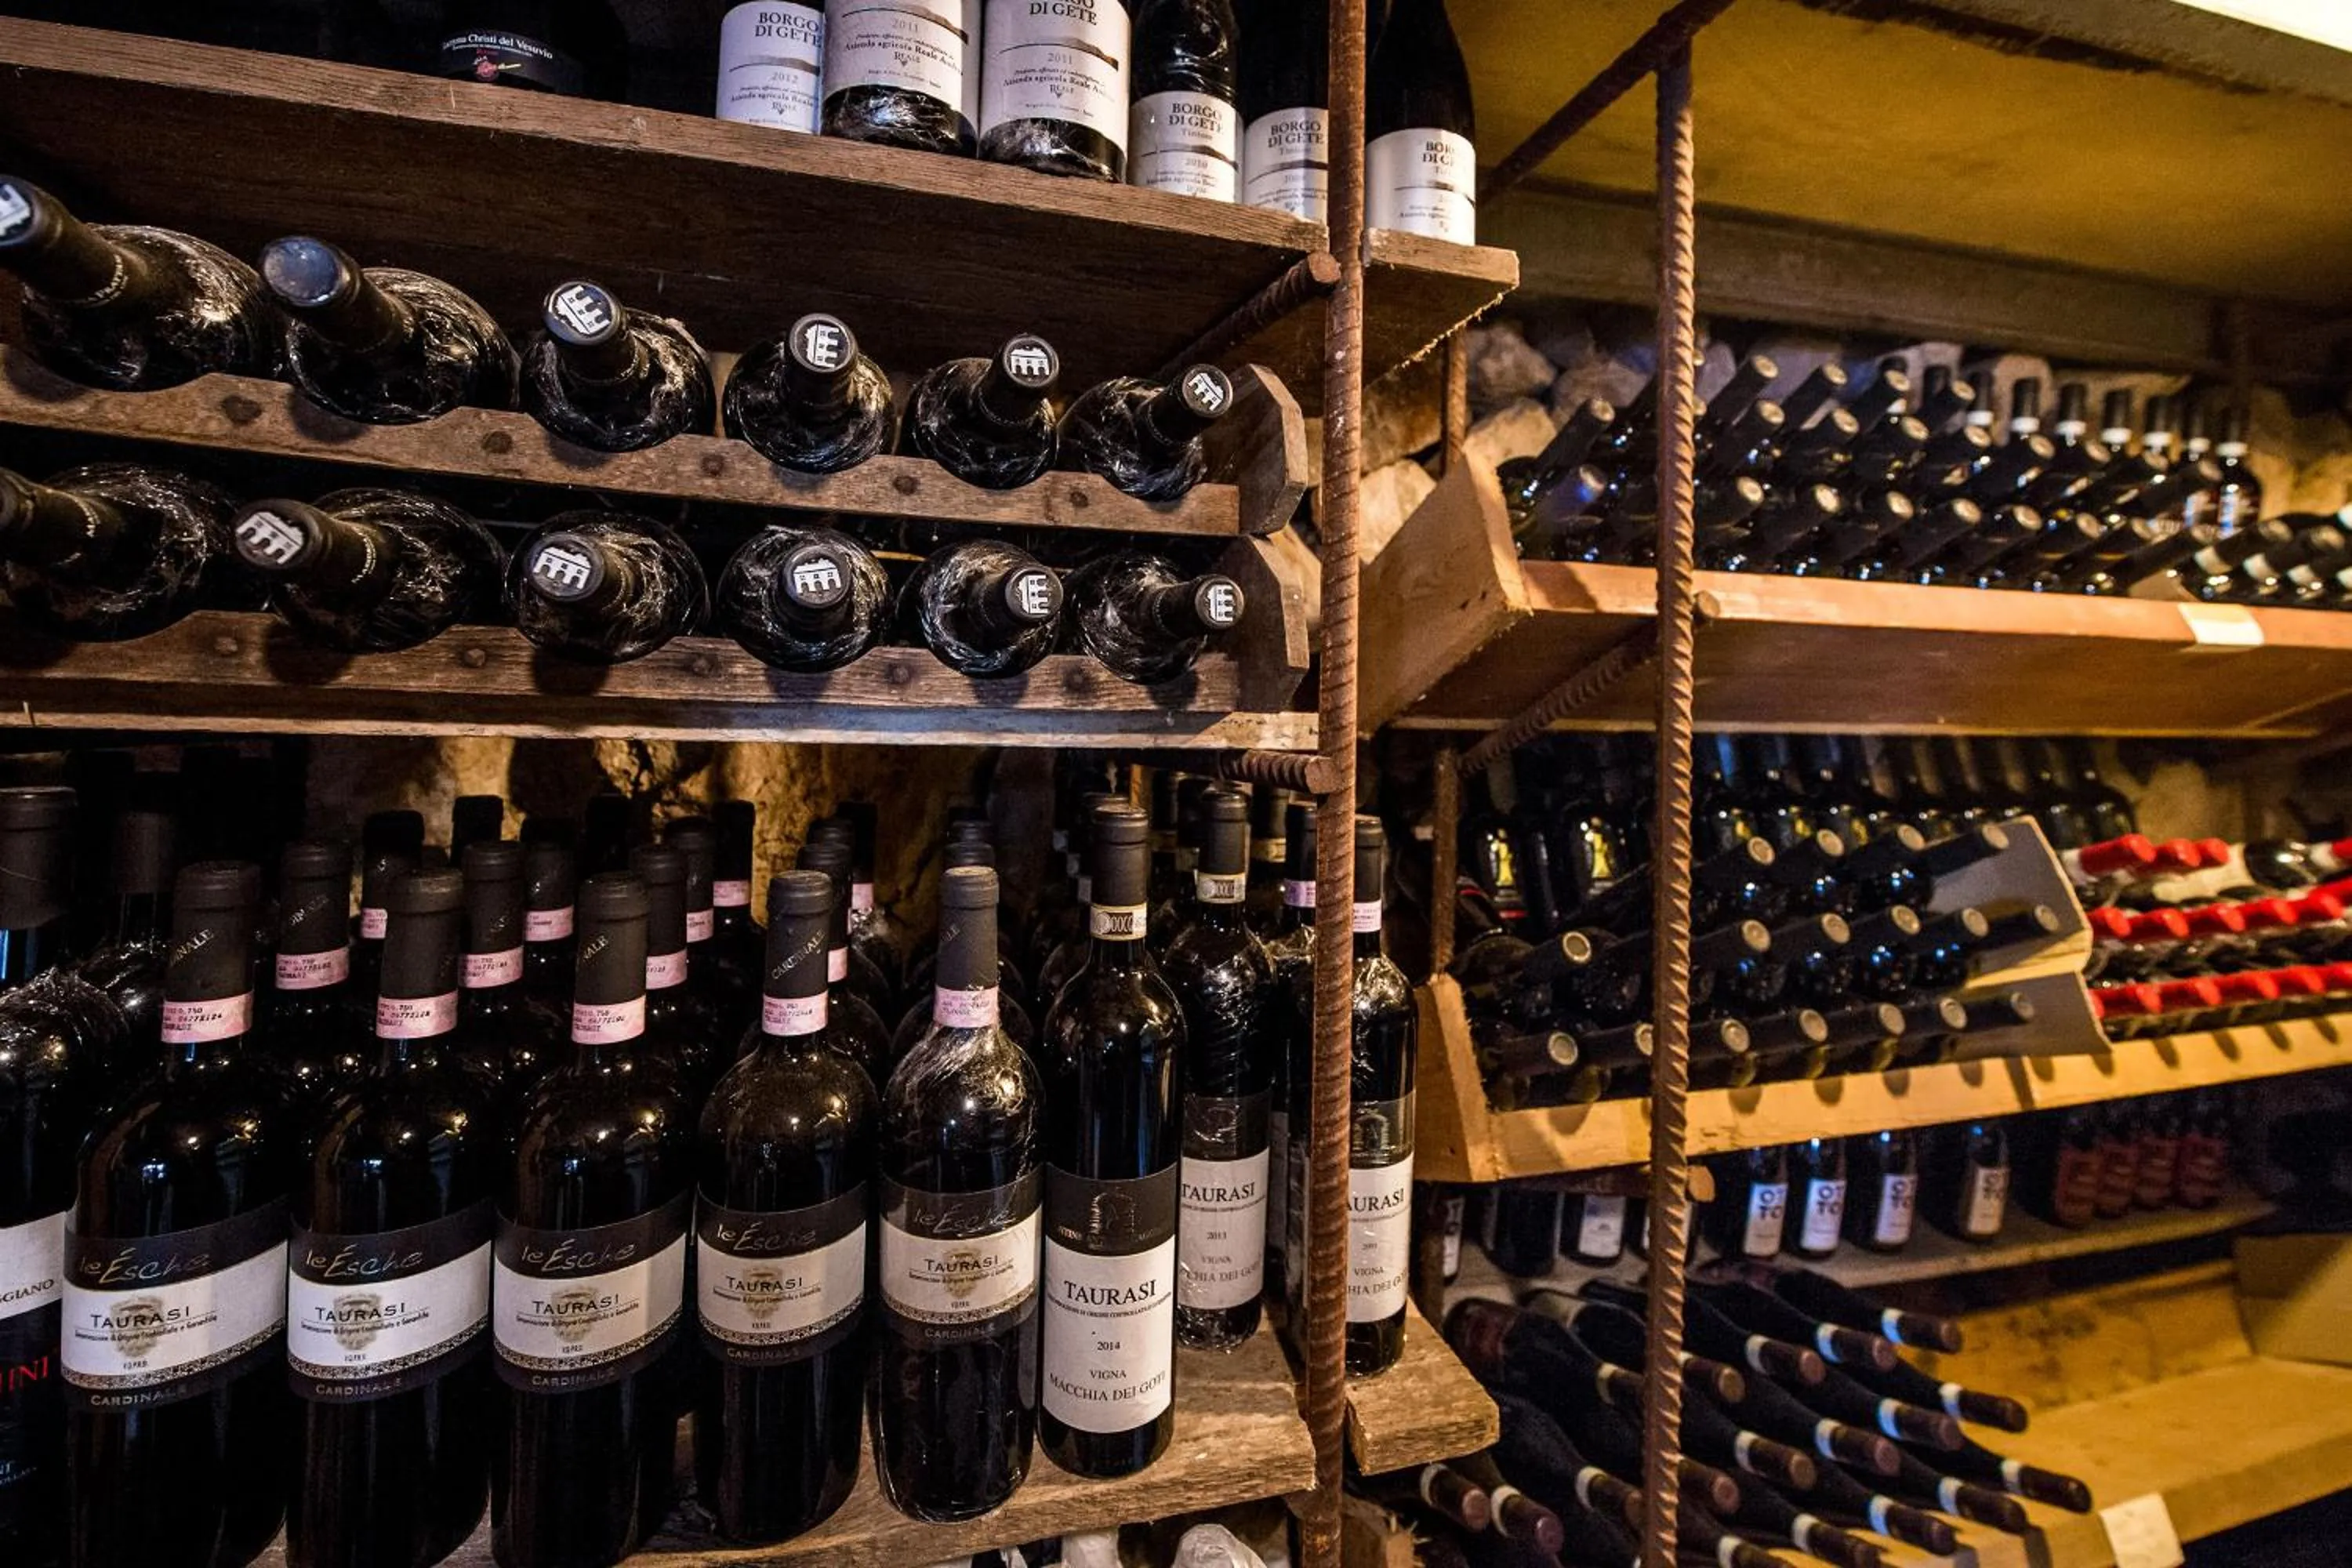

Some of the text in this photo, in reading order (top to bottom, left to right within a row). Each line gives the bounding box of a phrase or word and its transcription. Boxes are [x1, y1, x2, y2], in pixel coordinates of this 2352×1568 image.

[759, 12, 819, 32] BORGO
[1030, 3, 1047, 15] DI
[1052, 4, 1097, 26] GETE
[891, 18, 919, 33] 2011
[754, 25, 822, 48] DI GETE
[498, 36, 514, 47] del
[515, 39, 554, 60] Vesuvio
[1047, 53, 1073, 64] 2011
[770, 71, 798, 84] 2012
[1169, 115, 1185, 126] DI
[1271, 120, 1321, 136] BORGO
[1268, 132, 1323, 147] DI GETE
[1423, 153, 1438, 164] DI
[1182, 1182, 1254, 1202] TAURASI
[913, 1208, 936, 1225] le
[717, 1224, 736, 1241] le
[307, 1250, 327, 1268] le
[521, 1245, 543, 1264] le
[924, 1255, 998, 1273] TAURASI
[1354, 1266, 1385, 1276] VIGNA
[1220, 1270, 1238, 1281] DEI
[725, 1276, 803, 1293] TAURASI
[1064, 1279, 1156, 1305] TAURASI
[1373, 1281, 1391, 1294] DEI
[315, 1302, 405, 1323] TAURASI
[532, 1294, 619, 1315] TAURASI
[90, 1306, 191, 1329] TAURASI
[728, 1346, 798, 1361] CARDINALE
[1097, 1341, 1120, 1351] 2014
[532, 1371, 615, 1387] CARDINALE
[1090, 1370, 1127, 1379] VIGNA
[316, 1378, 401, 1397] CARDINALE
[1050, 1372, 1166, 1401] MACCHIA DEI GOTI
[90, 1385, 187, 1406] CARDINALE
